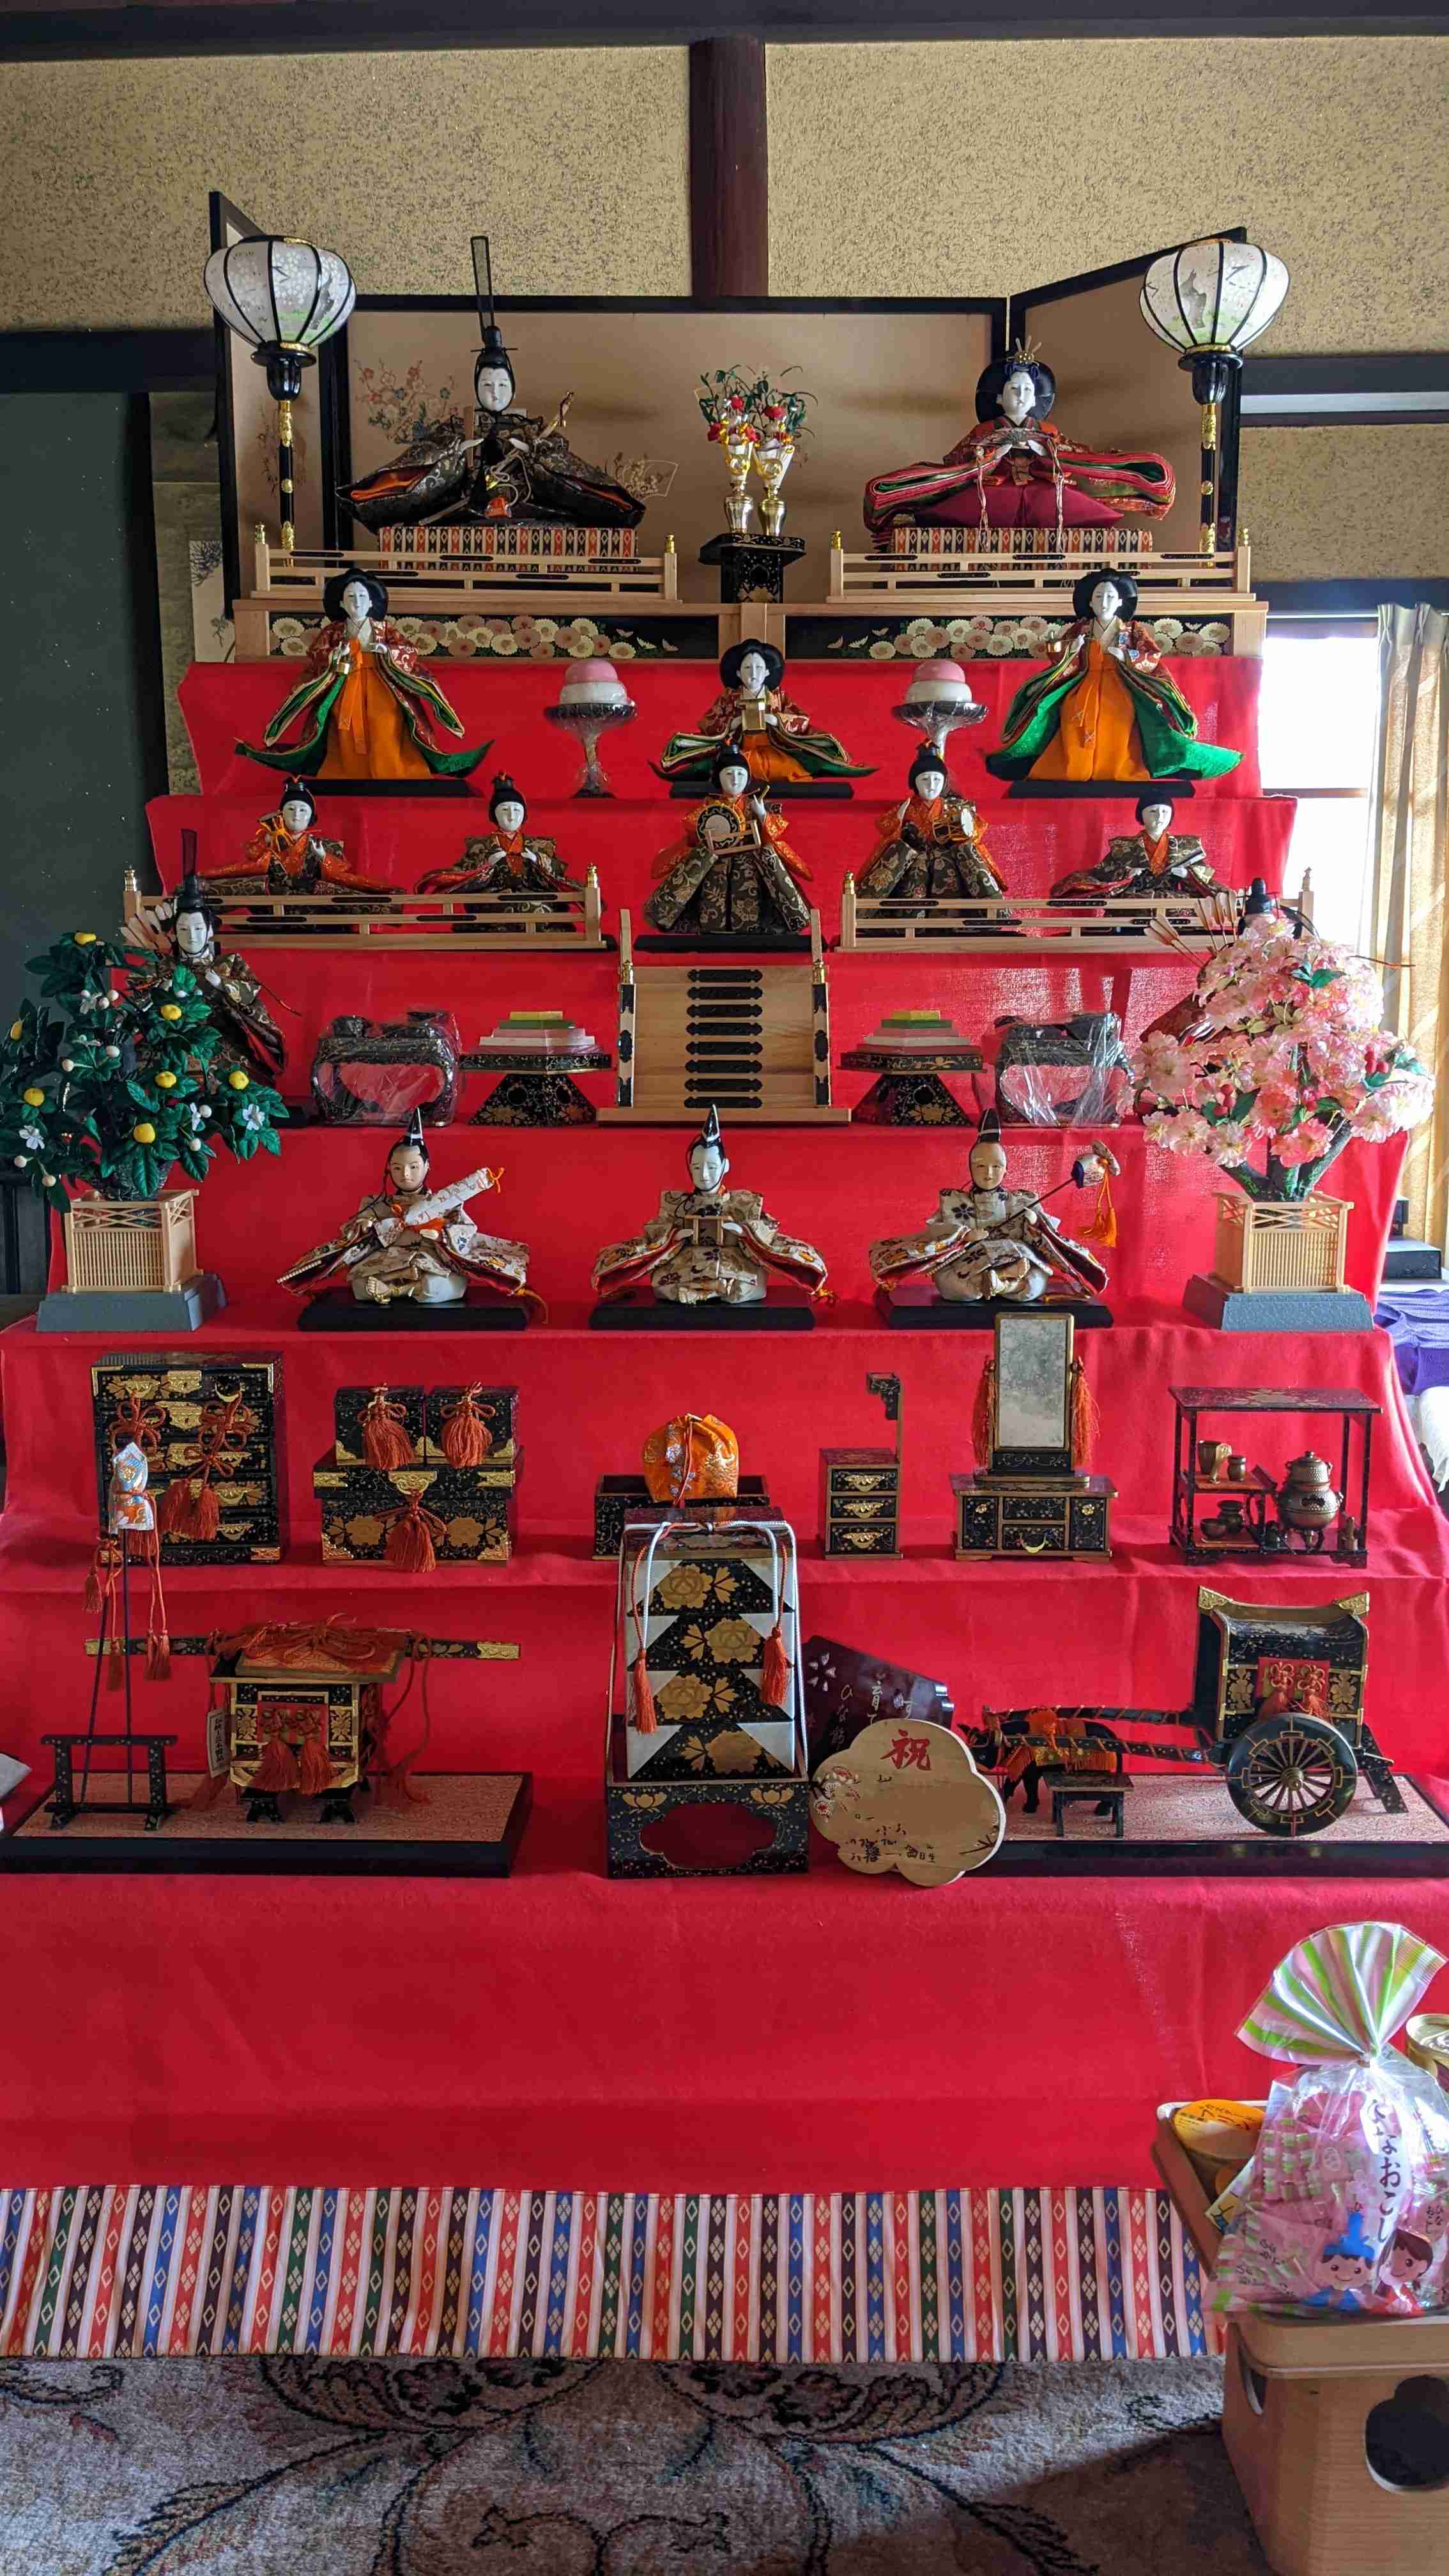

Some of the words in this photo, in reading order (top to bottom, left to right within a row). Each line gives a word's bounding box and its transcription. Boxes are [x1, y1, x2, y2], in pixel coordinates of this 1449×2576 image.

[880, 1729, 931, 1771] 祝
[1368, 2098, 1401, 2244] ひなおこし
